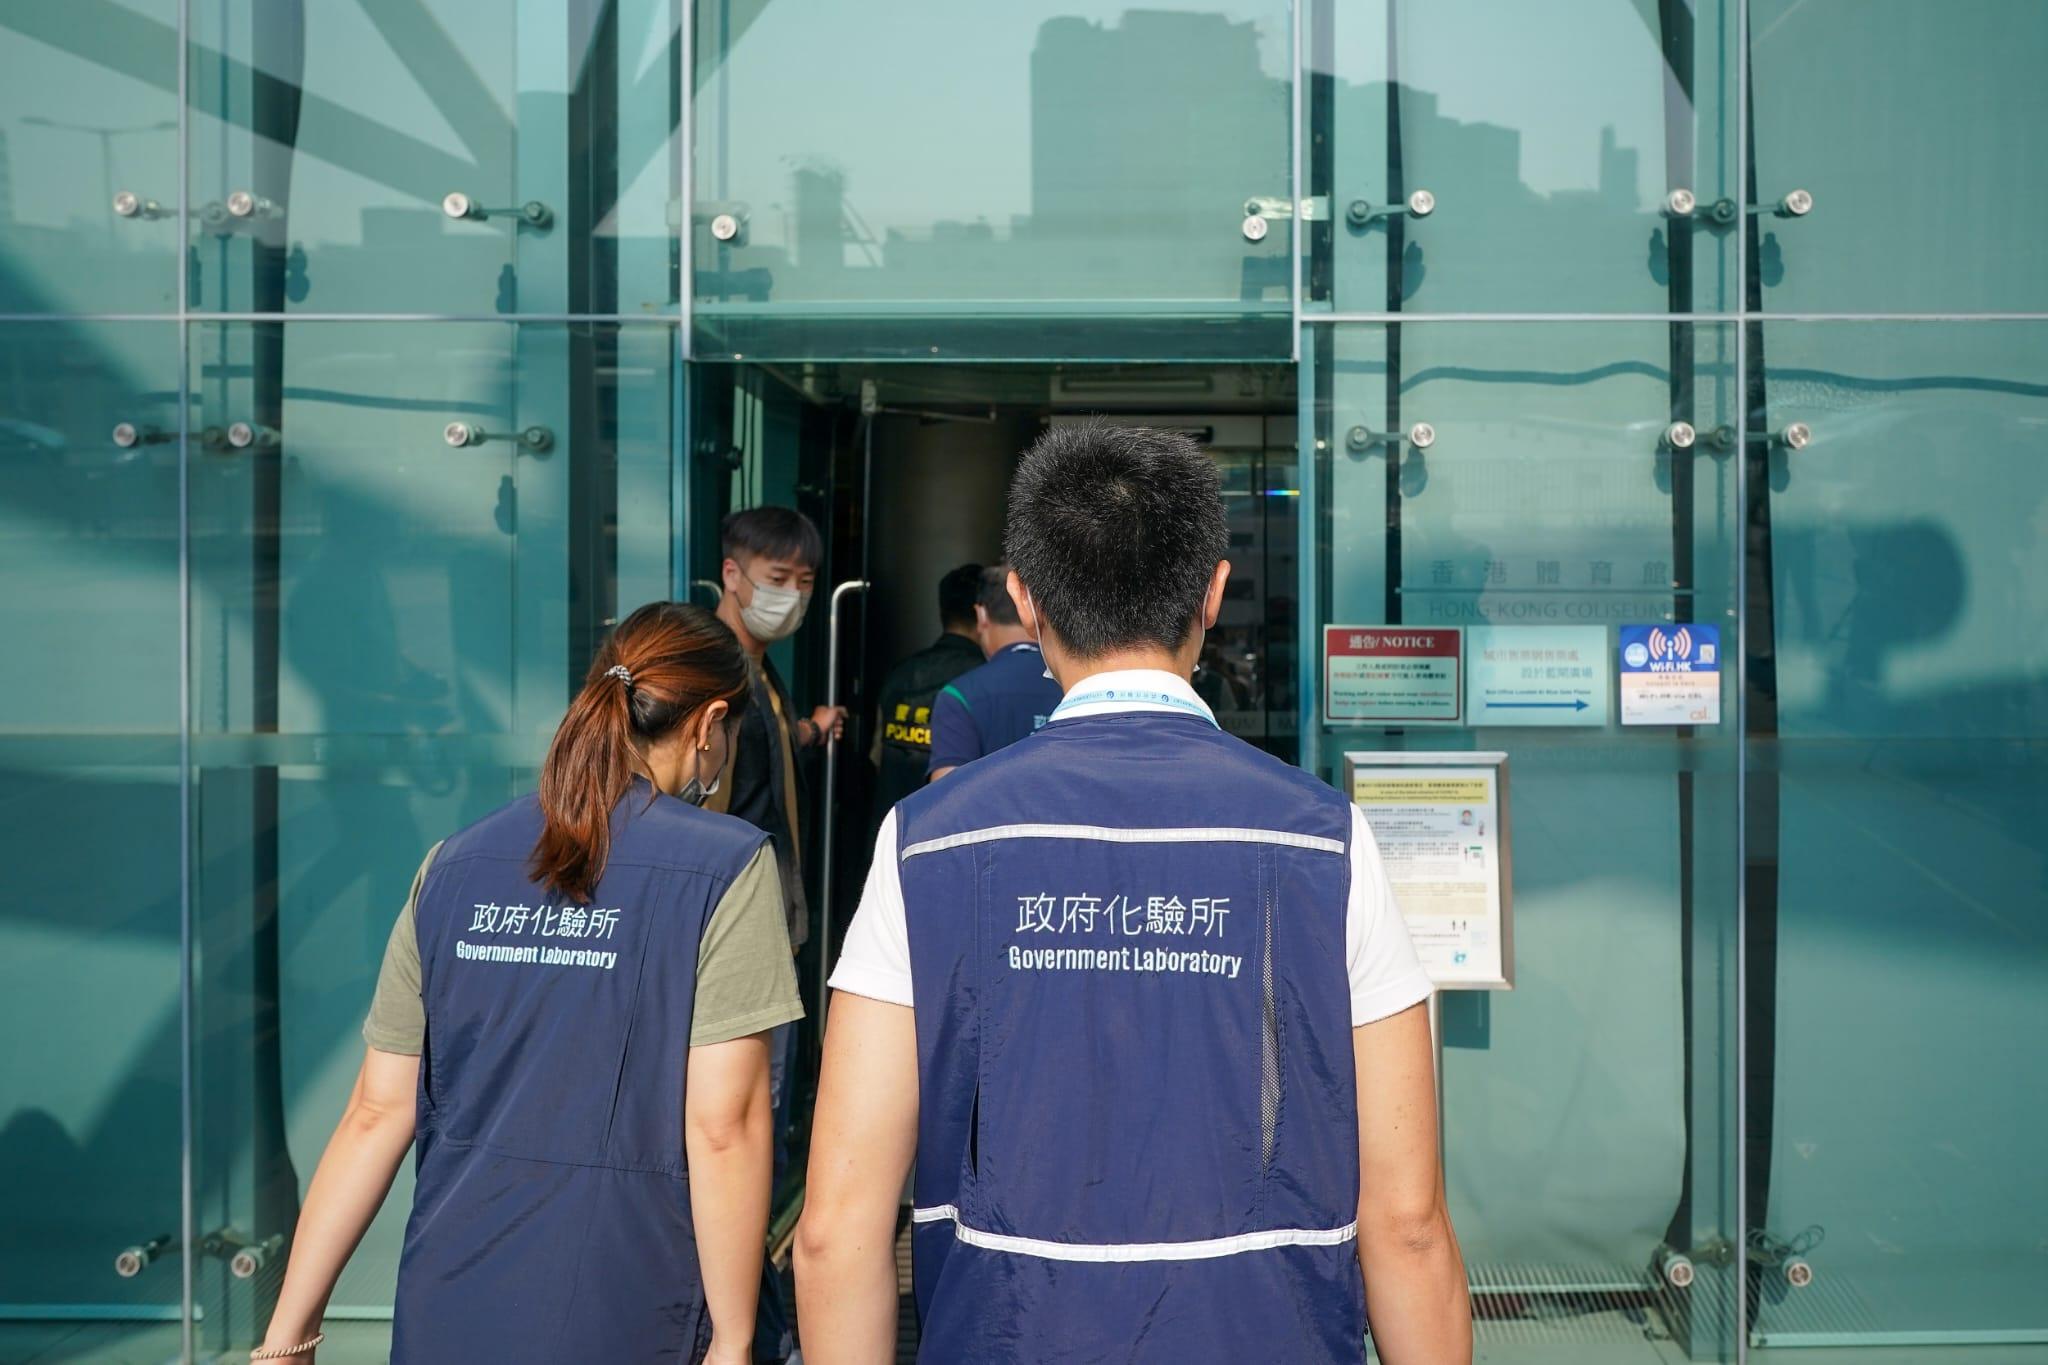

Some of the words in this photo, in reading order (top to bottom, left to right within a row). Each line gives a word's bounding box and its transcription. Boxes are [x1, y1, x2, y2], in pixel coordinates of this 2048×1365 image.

[1431, 560, 1668, 585] 香港體育館
[1429, 601, 1490, 618] HONG
[1497, 601, 1558, 618] KONG
[1564, 601, 1669, 618] COLISEUM
[1383, 636, 1435, 648] NOTICE
[468, 902, 621, 940] 政府化驗所
[1015, 892, 1231, 938] 政府化驗所
[456, 940, 538, 964] Government
[540, 946, 618, 970] Laboratory
[1009, 945, 1130, 970] Government
[1134, 947, 1243, 979] Laboratory
